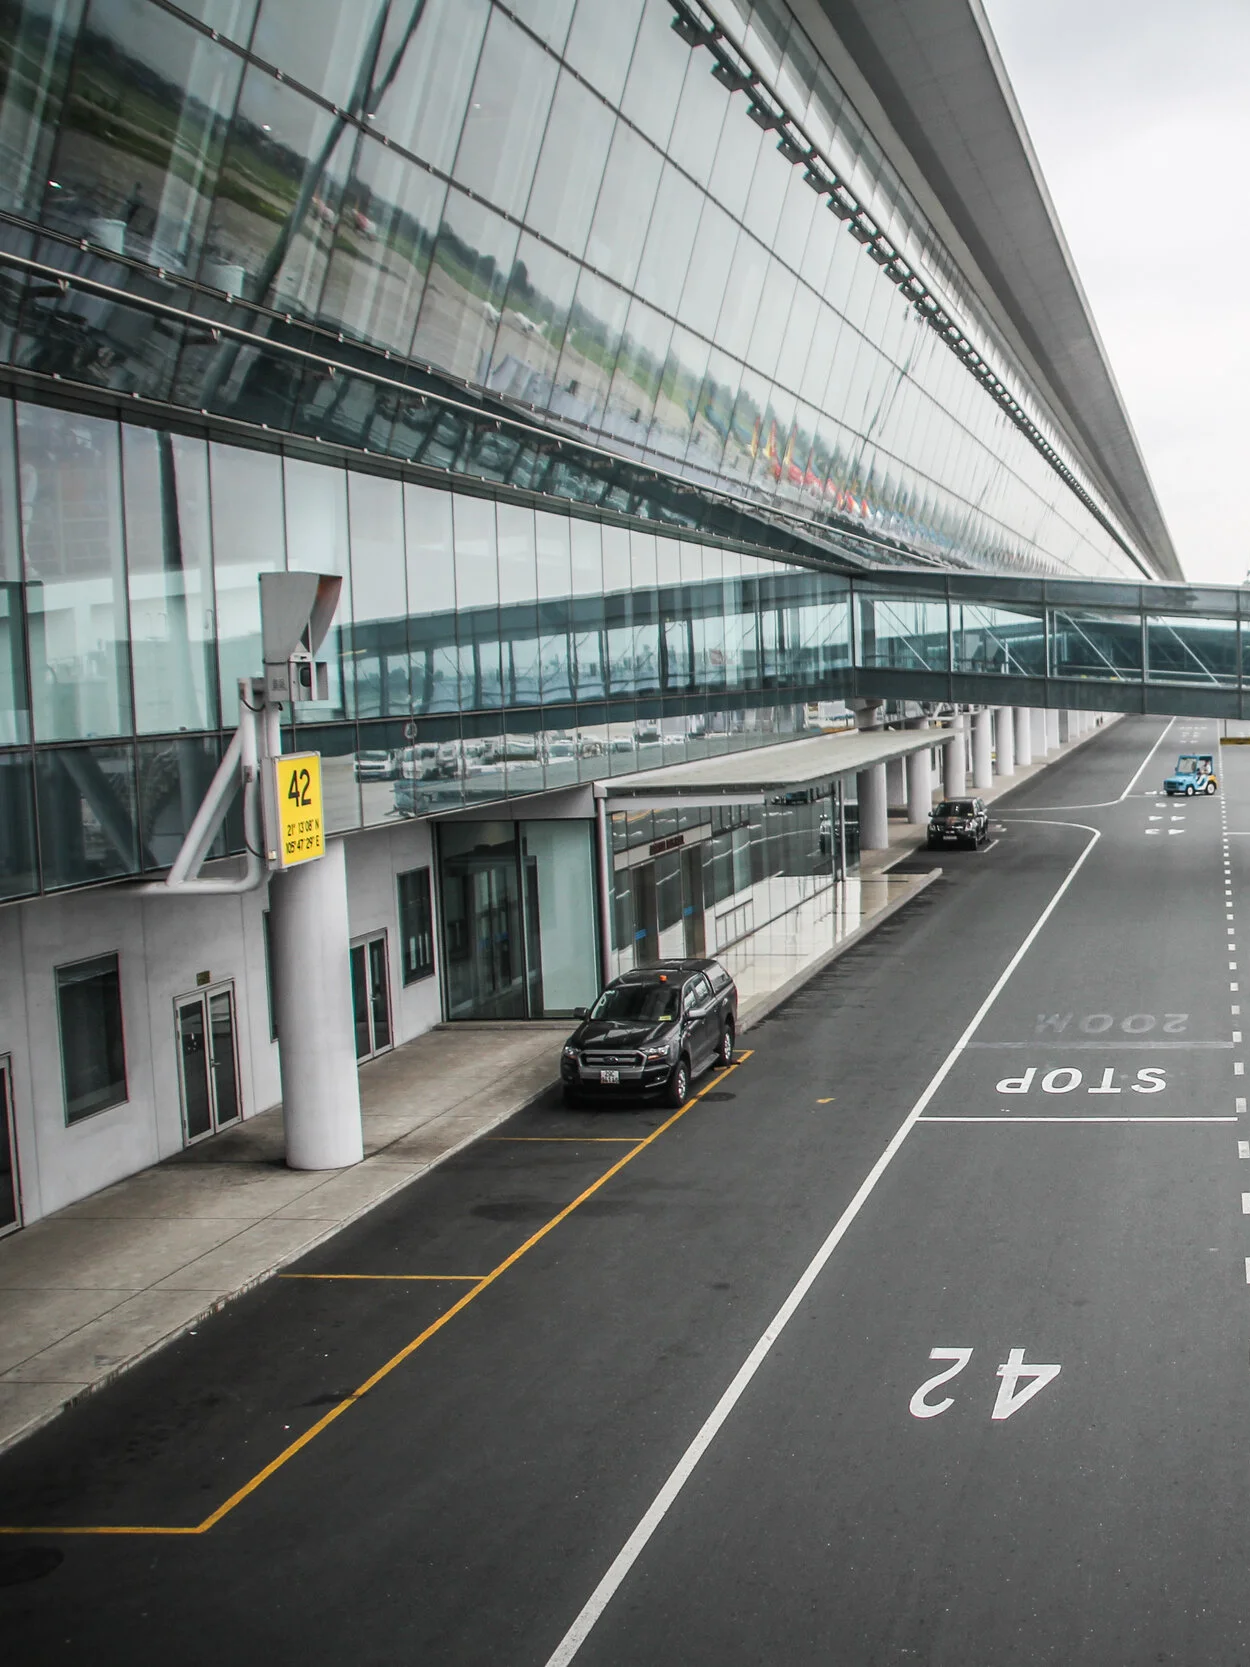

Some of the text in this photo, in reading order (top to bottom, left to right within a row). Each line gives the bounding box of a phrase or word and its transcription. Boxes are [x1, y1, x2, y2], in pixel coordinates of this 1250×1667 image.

[288, 768, 312, 808] 42
[996, 1067, 1167, 1094] STOP
[909, 1348, 1062, 1420] 42
